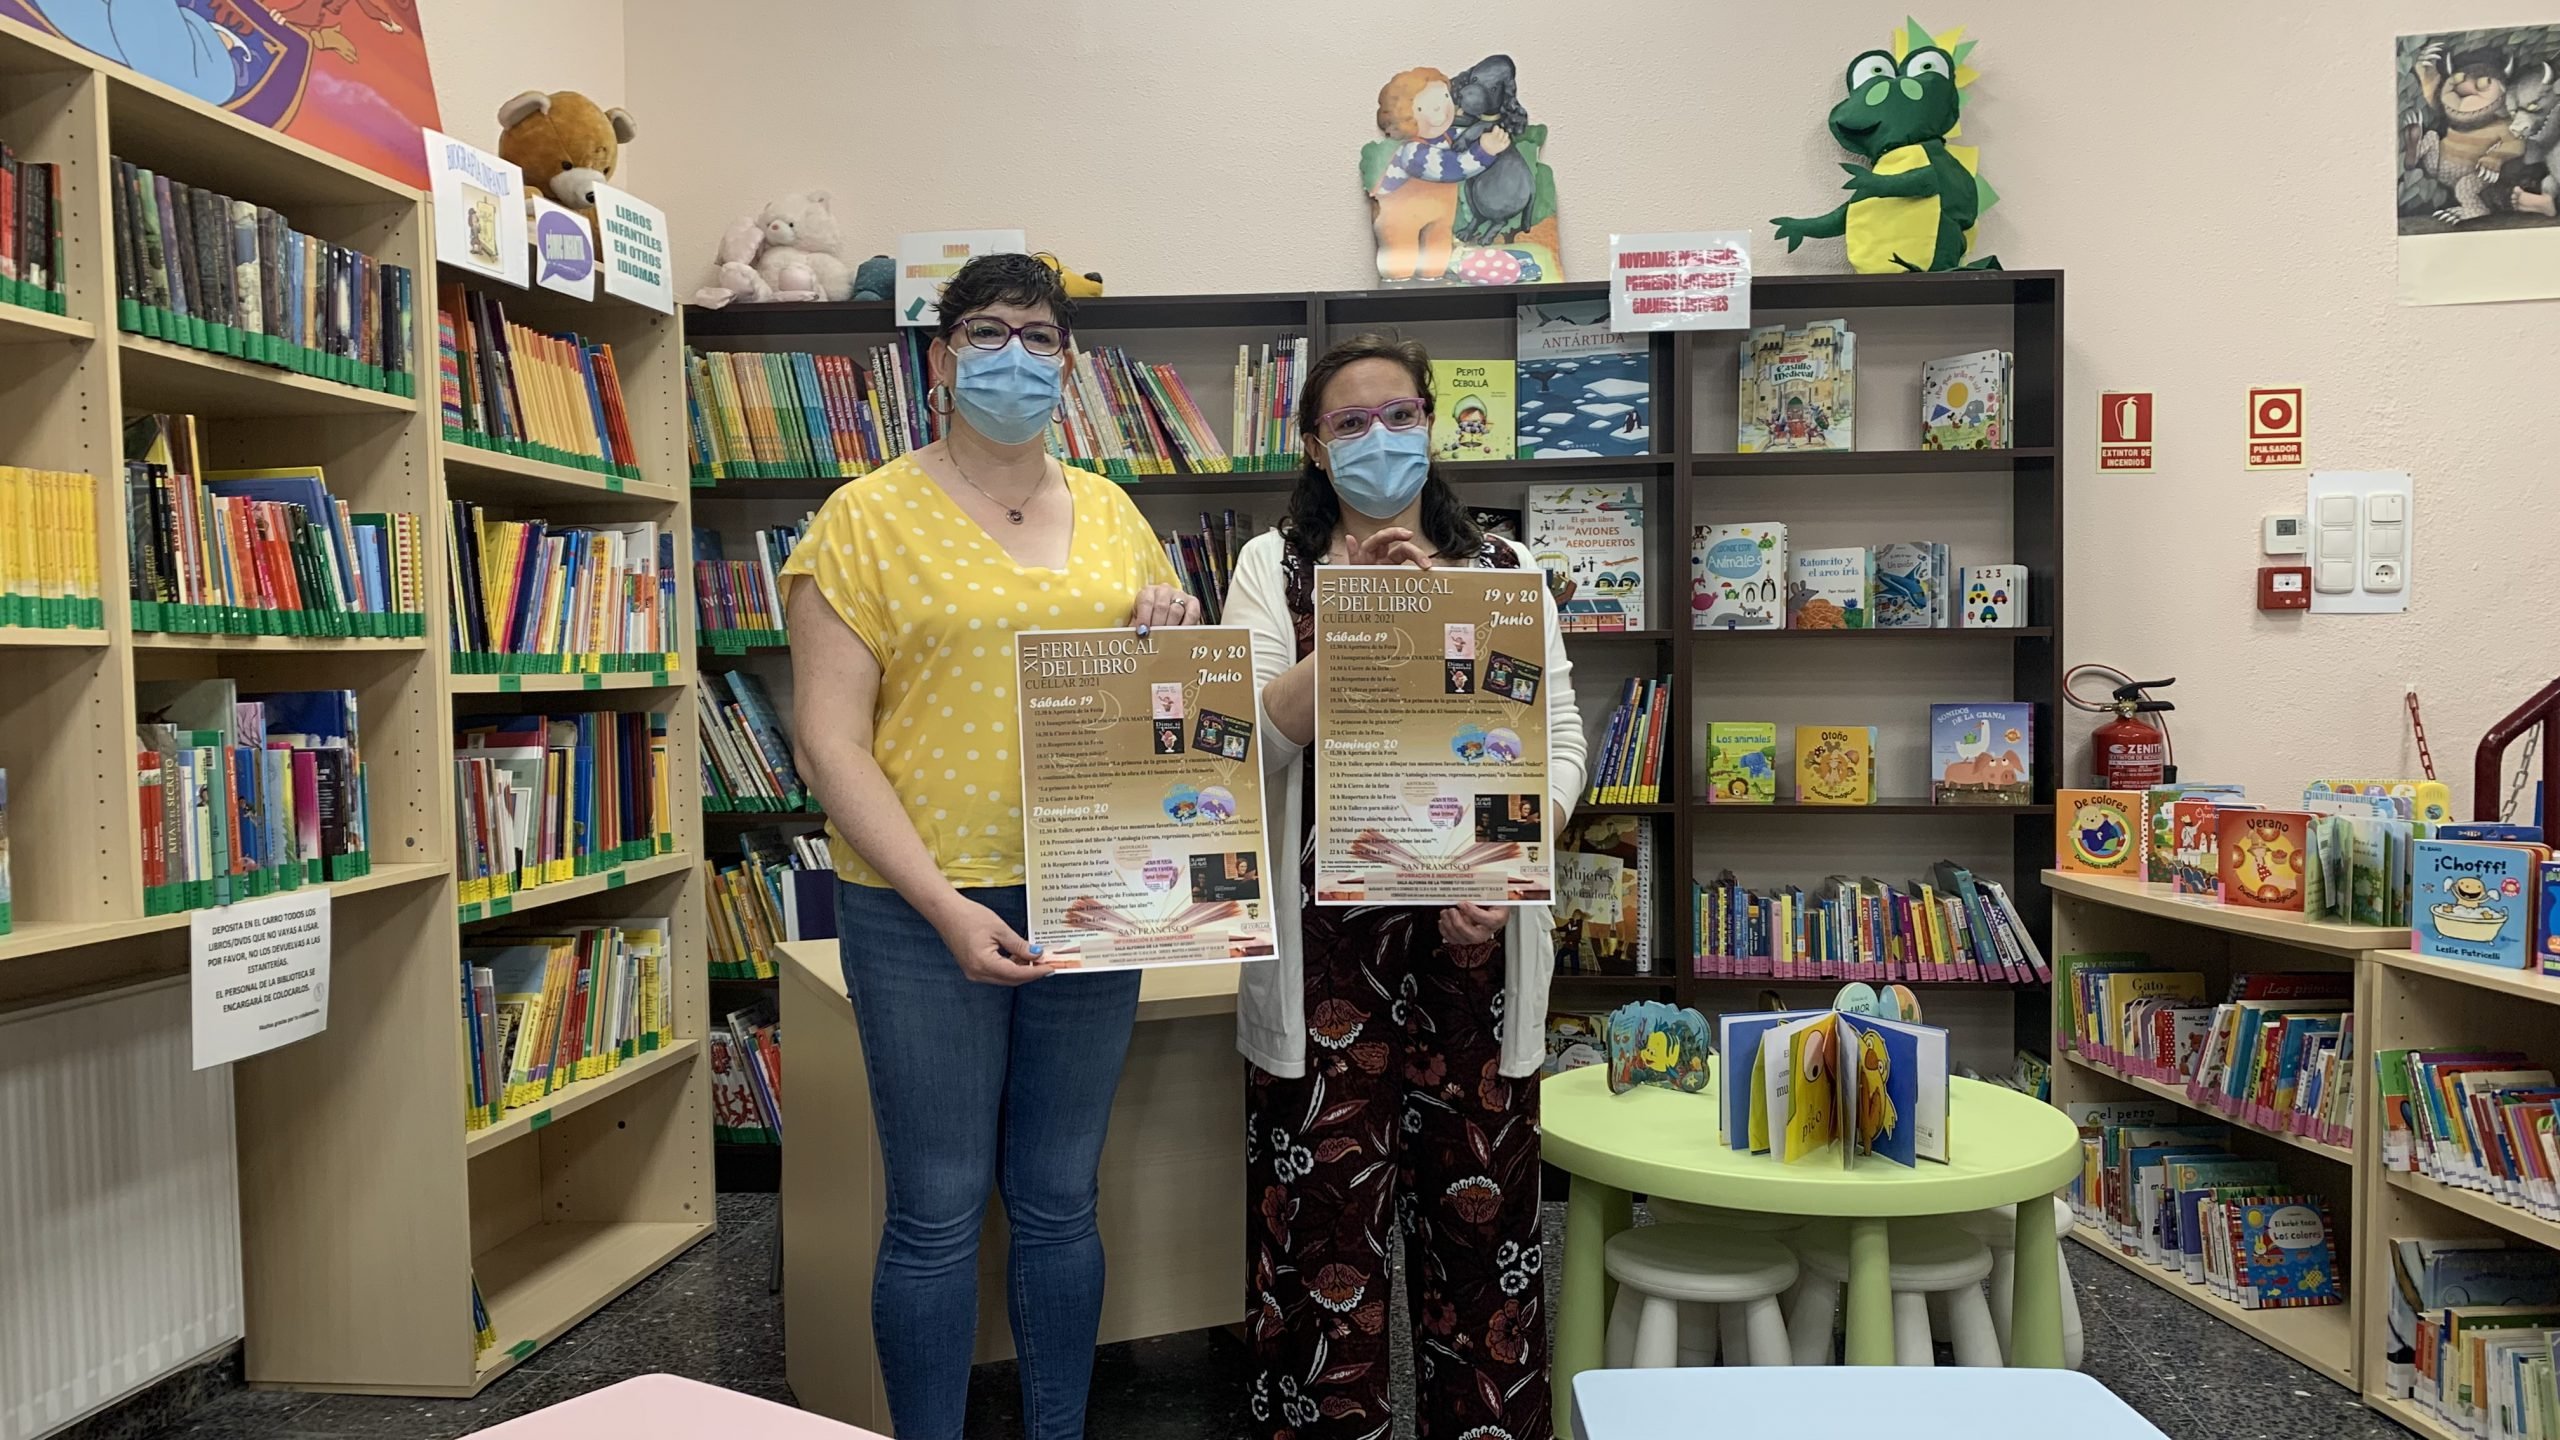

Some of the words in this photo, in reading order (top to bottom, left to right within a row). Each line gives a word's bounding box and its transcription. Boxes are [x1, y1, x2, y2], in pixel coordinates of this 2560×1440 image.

[616, 204, 652, 232] LIBROS
[606, 218, 663, 253] INFANTILES
[613, 239, 627, 257] EN
[629, 243, 662, 270] OTROS
[1618, 250, 1677, 269] NOVEDADES
[617, 258, 661, 286] IDIOMAS
[1625, 273, 1677, 291] PRIMEROS
[1542, 332, 1626, 349] ANTÁRTIDA
[1456, 367, 1485, 377] PEPITO
[1776, 362, 1812, 373] Castillo
[1452, 378, 1489, 389] CEBOLLA
[1775, 371, 1815, 381] Medieval
[2102, 449, 2139, 457] EXTINTOR
[2141, 448, 2151, 457] DE
[2253, 445, 2298, 454] PULSADOR
[2107, 458, 2146, 467] INCENDIOS
[2251, 455, 2263, 464] DE
[2265, 454, 2301, 463] ALARMA
[1579, 517, 1597, 525] gran
[1575, 527, 1620, 536] AVIONES
[1566, 539, 1636, 548] AEROPUERTOS
[1708, 555, 1763, 569] Animales
[1800, 557, 1843, 567] Ratoncito
[1845, 557, 1854, 568] y
[1808, 569, 1817, 577] el
[1819, 569, 1840, 577] arco
[1976, 570, 1983, 579] 1
[1985, 569, 1992, 579] 2
[1995, 569, 2002, 579] 3
[1339, 577, 1391, 594] FERIA
[1394, 577, 1454, 594] LOCAL
[1321, 581, 1336, 606] XII
[1484, 588, 1501, 601] 19
[1504, 592, 1515, 605] y
[1519, 590, 1539, 603] 20
[1338, 595, 1374, 612] DEL
[1378, 595, 1432, 612] LIBRO
[1322, 614, 1372, 624] CUELLAR
[1374, 614, 1395, 623] 2021
[1490, 611, 1534, 628] Junio
[1325, 631, 1372, 643] Sábado
[1374, 632, 1388, 643] 19
[1040, 641, 1094, 659] FERIA
[1097, 638, 1159, 656] LOCAL
[1191, 645, 1208, 659] 19
[1212, 648, 1222, 662] y
[1227, 645, 1247, 659] 20
[1024, 646, 1038, 672] XII
[1041, 660, 1077, 678] DEL
[1081, 657, 1137, 676] LIBRO
[1025, 679, 1076, 690] CUELLAR
[1079, 677, 1100, 687] 2021
[1197, 668, 1242, 686] Junio
[1029, 696, 1077, 709] Sábado
[1080, 695, 1094, 706] 19
[1937, 707, 1969, 723] SONIDOS
[1952, 716, 1962, 726] DE
[1964, 713, 1975, 721] LA
[1976, 711, 2006, 721] GRANJA
[1716, 735, 1732, 744] Los
[1734, 734, 1771, 744] animales
[1821, 731, 1849, 742] Otoño
[1324, 738, 1380, 751] Domingo
[1383, 739, 1398, 750] 20
[165, 758, 176, 807] SECRETO
[1032, 804, 1090, 817] Domingo
[1093, 802, 1108, 815] 20
[2074, 797, 2088, 810] De
[2091, 795, 2129, 813] colores
[2247, 818, 2290, 833] Verano
[1401, 863, 1418, 871] SAN
[1421, 862, 1471, 871] FRANCISCO
[2434, 855, 2507, 875] ¡Chofff!
[1563, 865, 1614, 882] Mujeres
[1556, 887, 1619, 901] exploradoras
[212, 923, 244, 936] DEPOSITA
[244, 920, 253, 929] EN
[254, 919, 261, 927] EL
[262, 914, 282, 925] CARRO
[284, 910, 305, 921] TODOS
[305, 908, 316, 917] LOS
[208, 936, 251, 952] LIBROS/DVDS
[253, 934, 266, 943] QUE
[267, 931, 277, 939] NO
[278, 927, 297, 938] VAYAS
[298, 925, 303, 933] A
[303, 922, 319, 932] USAR.
[1118, 928, 1136, 937] SAN
[1138, 924, 1189, 936] FRANCISCO
[208, 958, 222, 967] POR
[223, 953, 248, 964] FAVOR,
[248, 950, 258, 958] NO
[260, 947, 271, 956] LOS
[272, 940, 305, 954] DEVUELVAS
[305, 937, 310, 946] A
[311, 936, 321, 944] LAS
[2435, 945, 2459, 955] Leslie
[2461, 948, 2501, 961] Patricelli
[248, 957, 289, 974] ESTANTERÍAS.
[216, 990, 223, 999] EL
[225, 983, 258, 999] PERSONAL
[259, 980, 267, 989] DE
[268, 977, 276, 986] LA
[277, 970, 309, 985] BIBLIOTECA
[309, 967, 316, 976] SE
[2132, 977, 2164, 991] Gato
[2262, 983, 2290, 997] ¡Los
[223, 994, 262, 1013] ENCARGARÁ
[263, 994, 272, 1003] DE
[273, 984, 310, 1000] COLOCARLOS.
[2100, 1108, 2111, 1120] el
[2116, 1109, 2155, 1123] perro
[1802, 1110, 1822, 1144] pico
[2274, 1231, 2289, 1241] Los
[2291, 1230, 2322, 1241] colores
